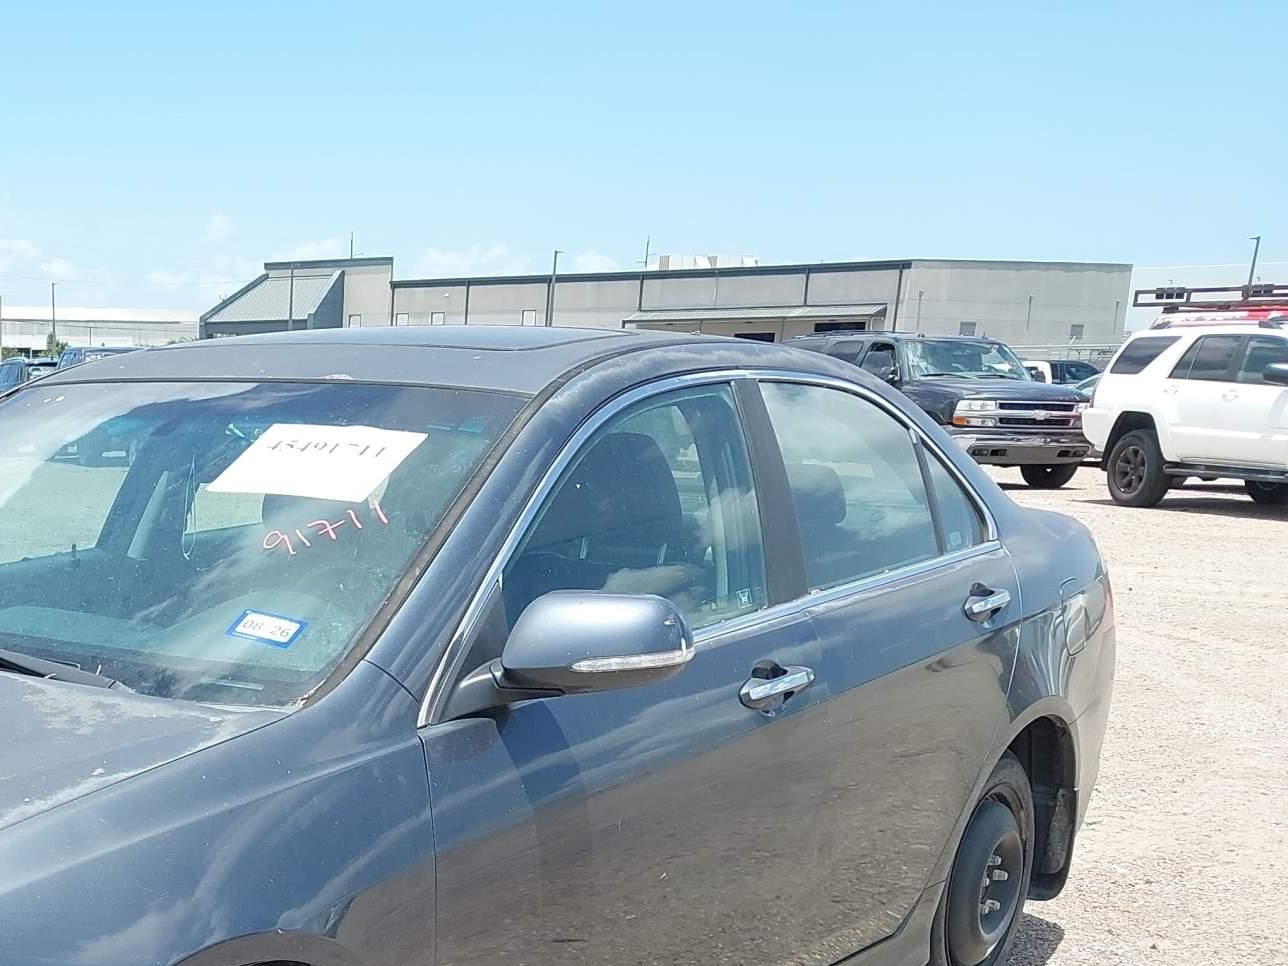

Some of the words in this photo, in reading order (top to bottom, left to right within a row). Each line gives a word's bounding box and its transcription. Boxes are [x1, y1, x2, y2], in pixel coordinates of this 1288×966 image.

[263, 500, 389, 556] 91711
[242, 619, 264, 631] 08
[269, 625, 292, 638] 26
